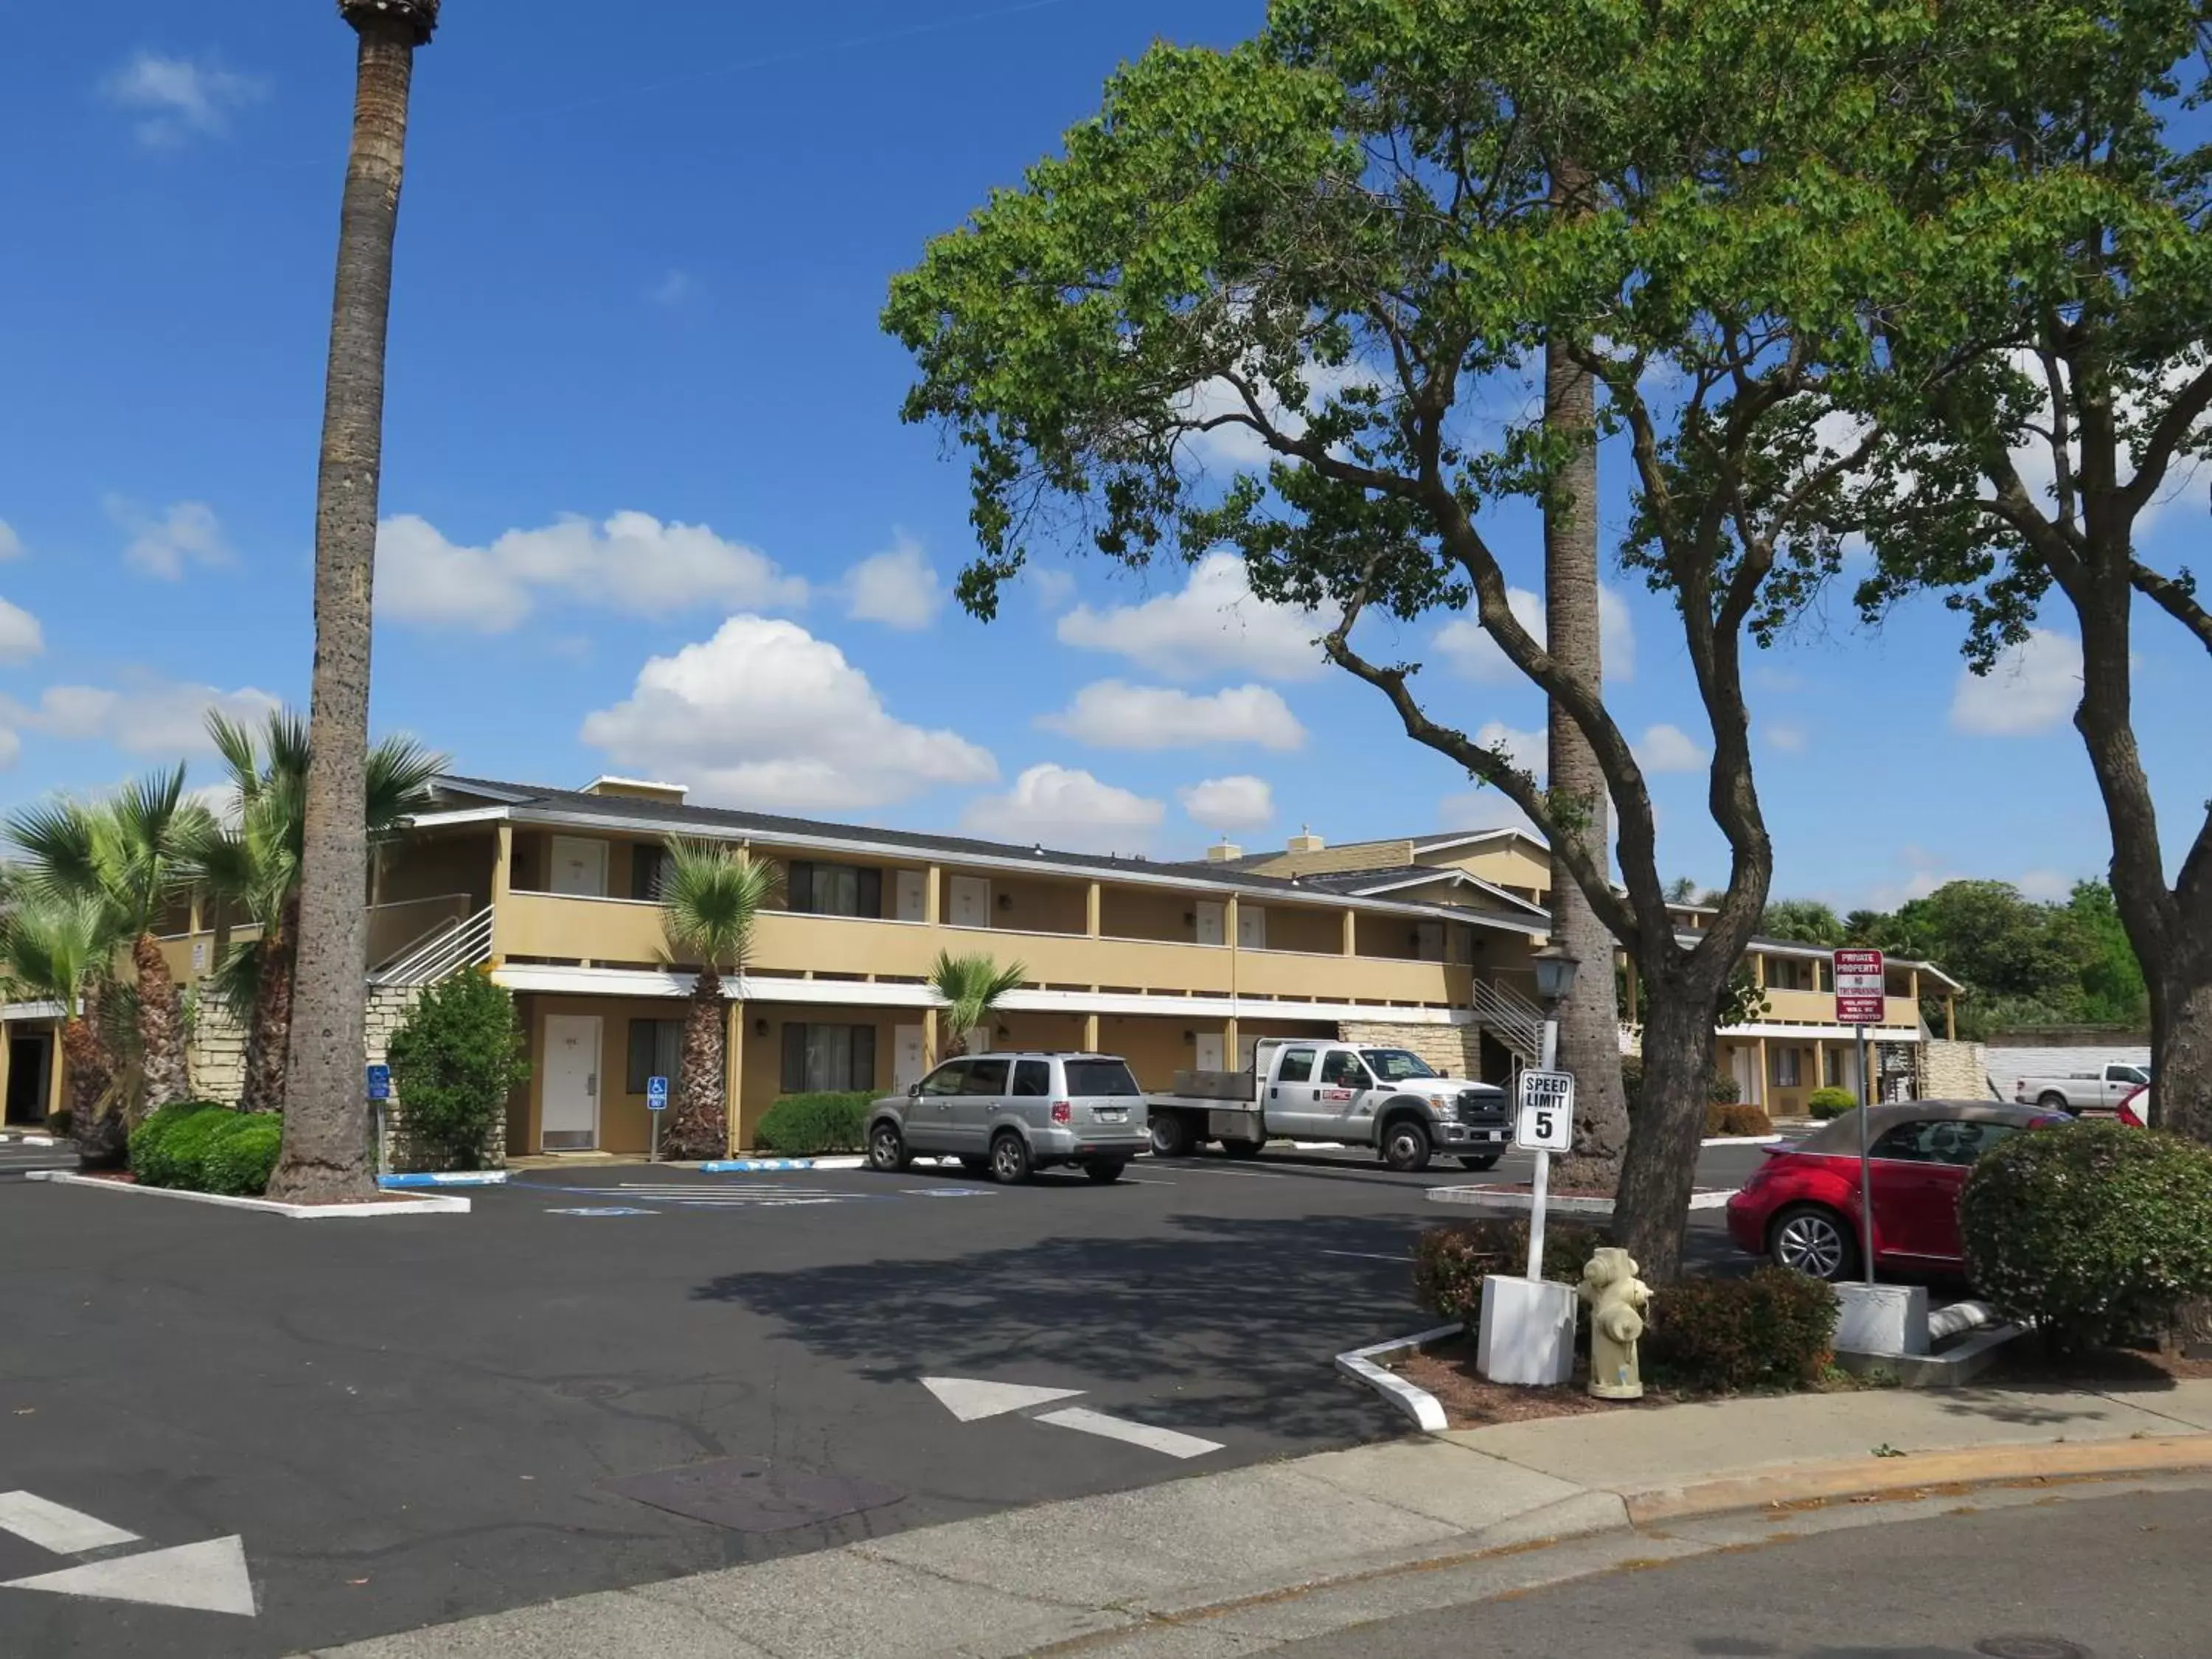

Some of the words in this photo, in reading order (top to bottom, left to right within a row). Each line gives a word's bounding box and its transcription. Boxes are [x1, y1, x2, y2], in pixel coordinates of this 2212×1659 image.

[1841, 953, 1874, 962] PRIVATE
[1837, 964, 1879, 973] PROPERTY
[1839, 987, 1881, 995] TRESPASSING
[1526, 1077, 1568, 1093] SPEED
[1526, 1093, 1565, 1109] LIMIT
[1536, 1111, 1552, 1138] 5
